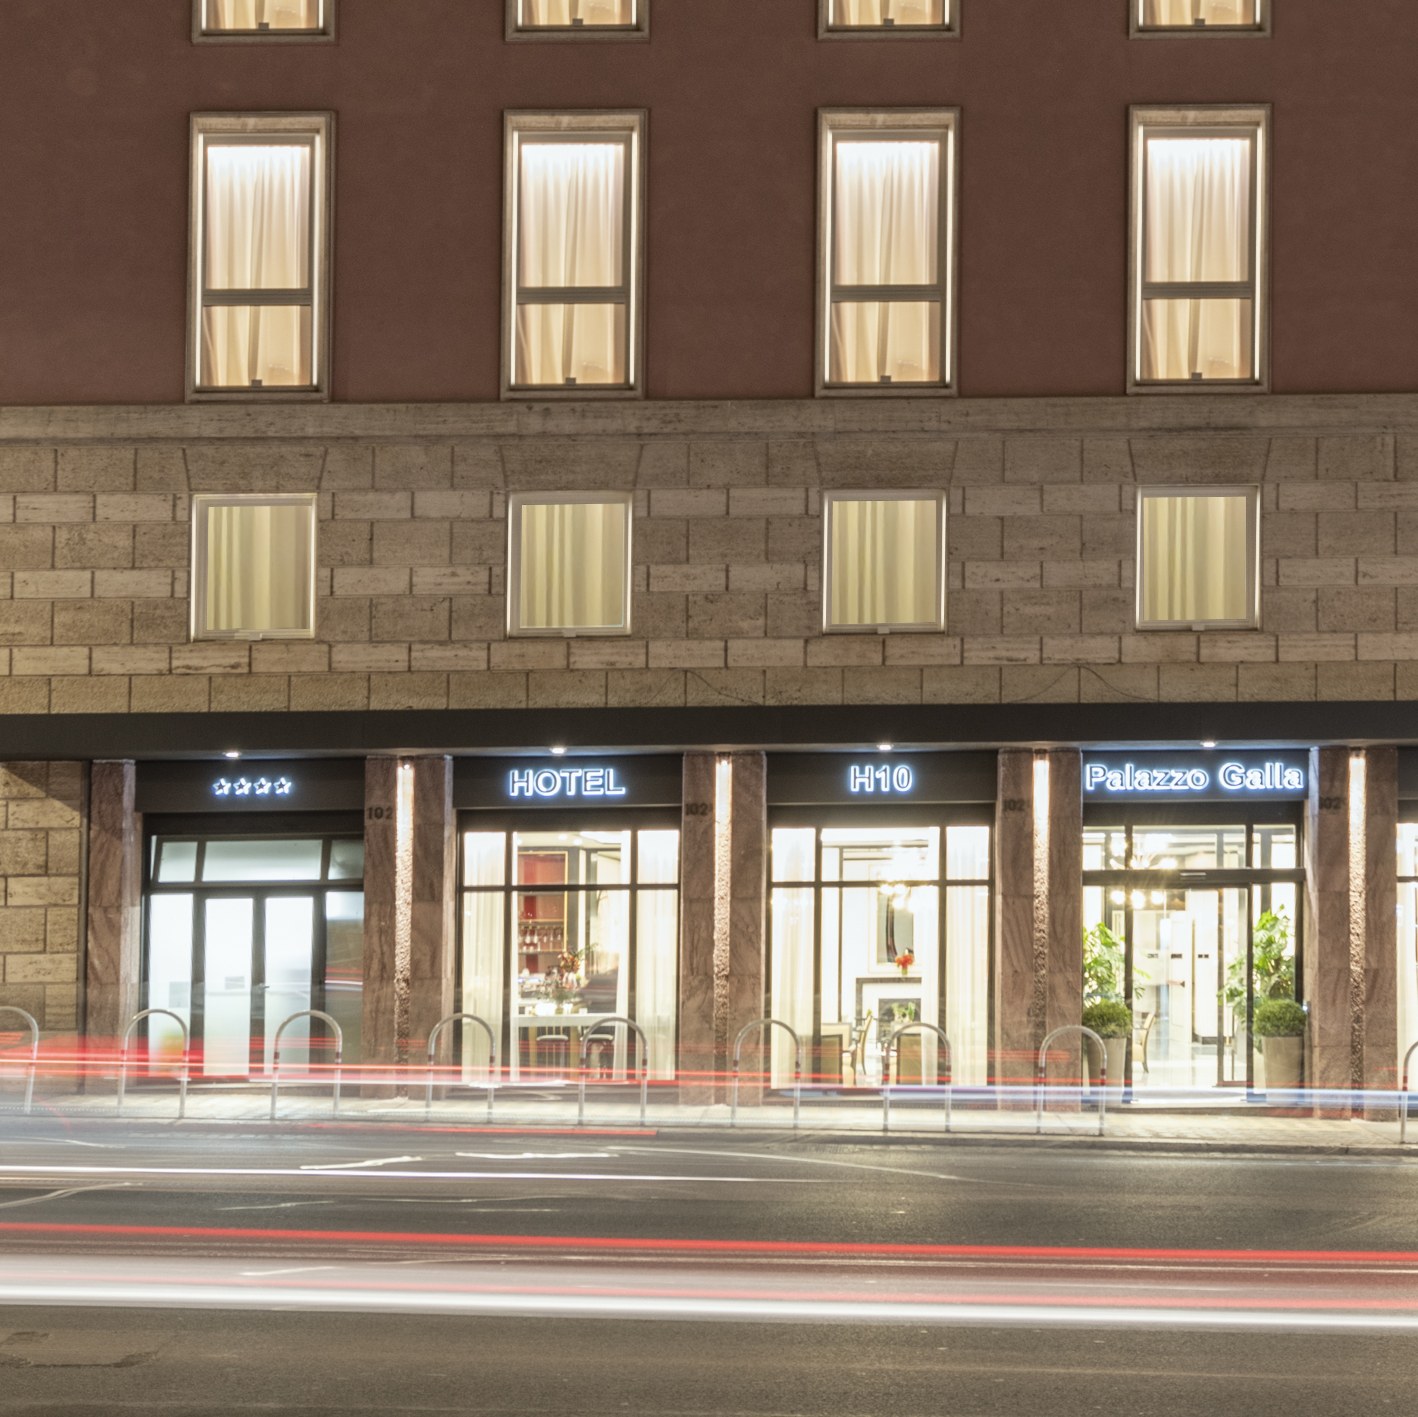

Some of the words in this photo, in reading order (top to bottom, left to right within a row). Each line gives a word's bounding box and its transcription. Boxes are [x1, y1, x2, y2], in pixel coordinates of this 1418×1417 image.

[509, 769, 626, 796] HOTEL
[850, 765, 913, 793] H10
[1085, 764, 1209, 790] Palazzo
[1219, 762, 1304, 789] Galla
[367, 807, 394, 820] 102
